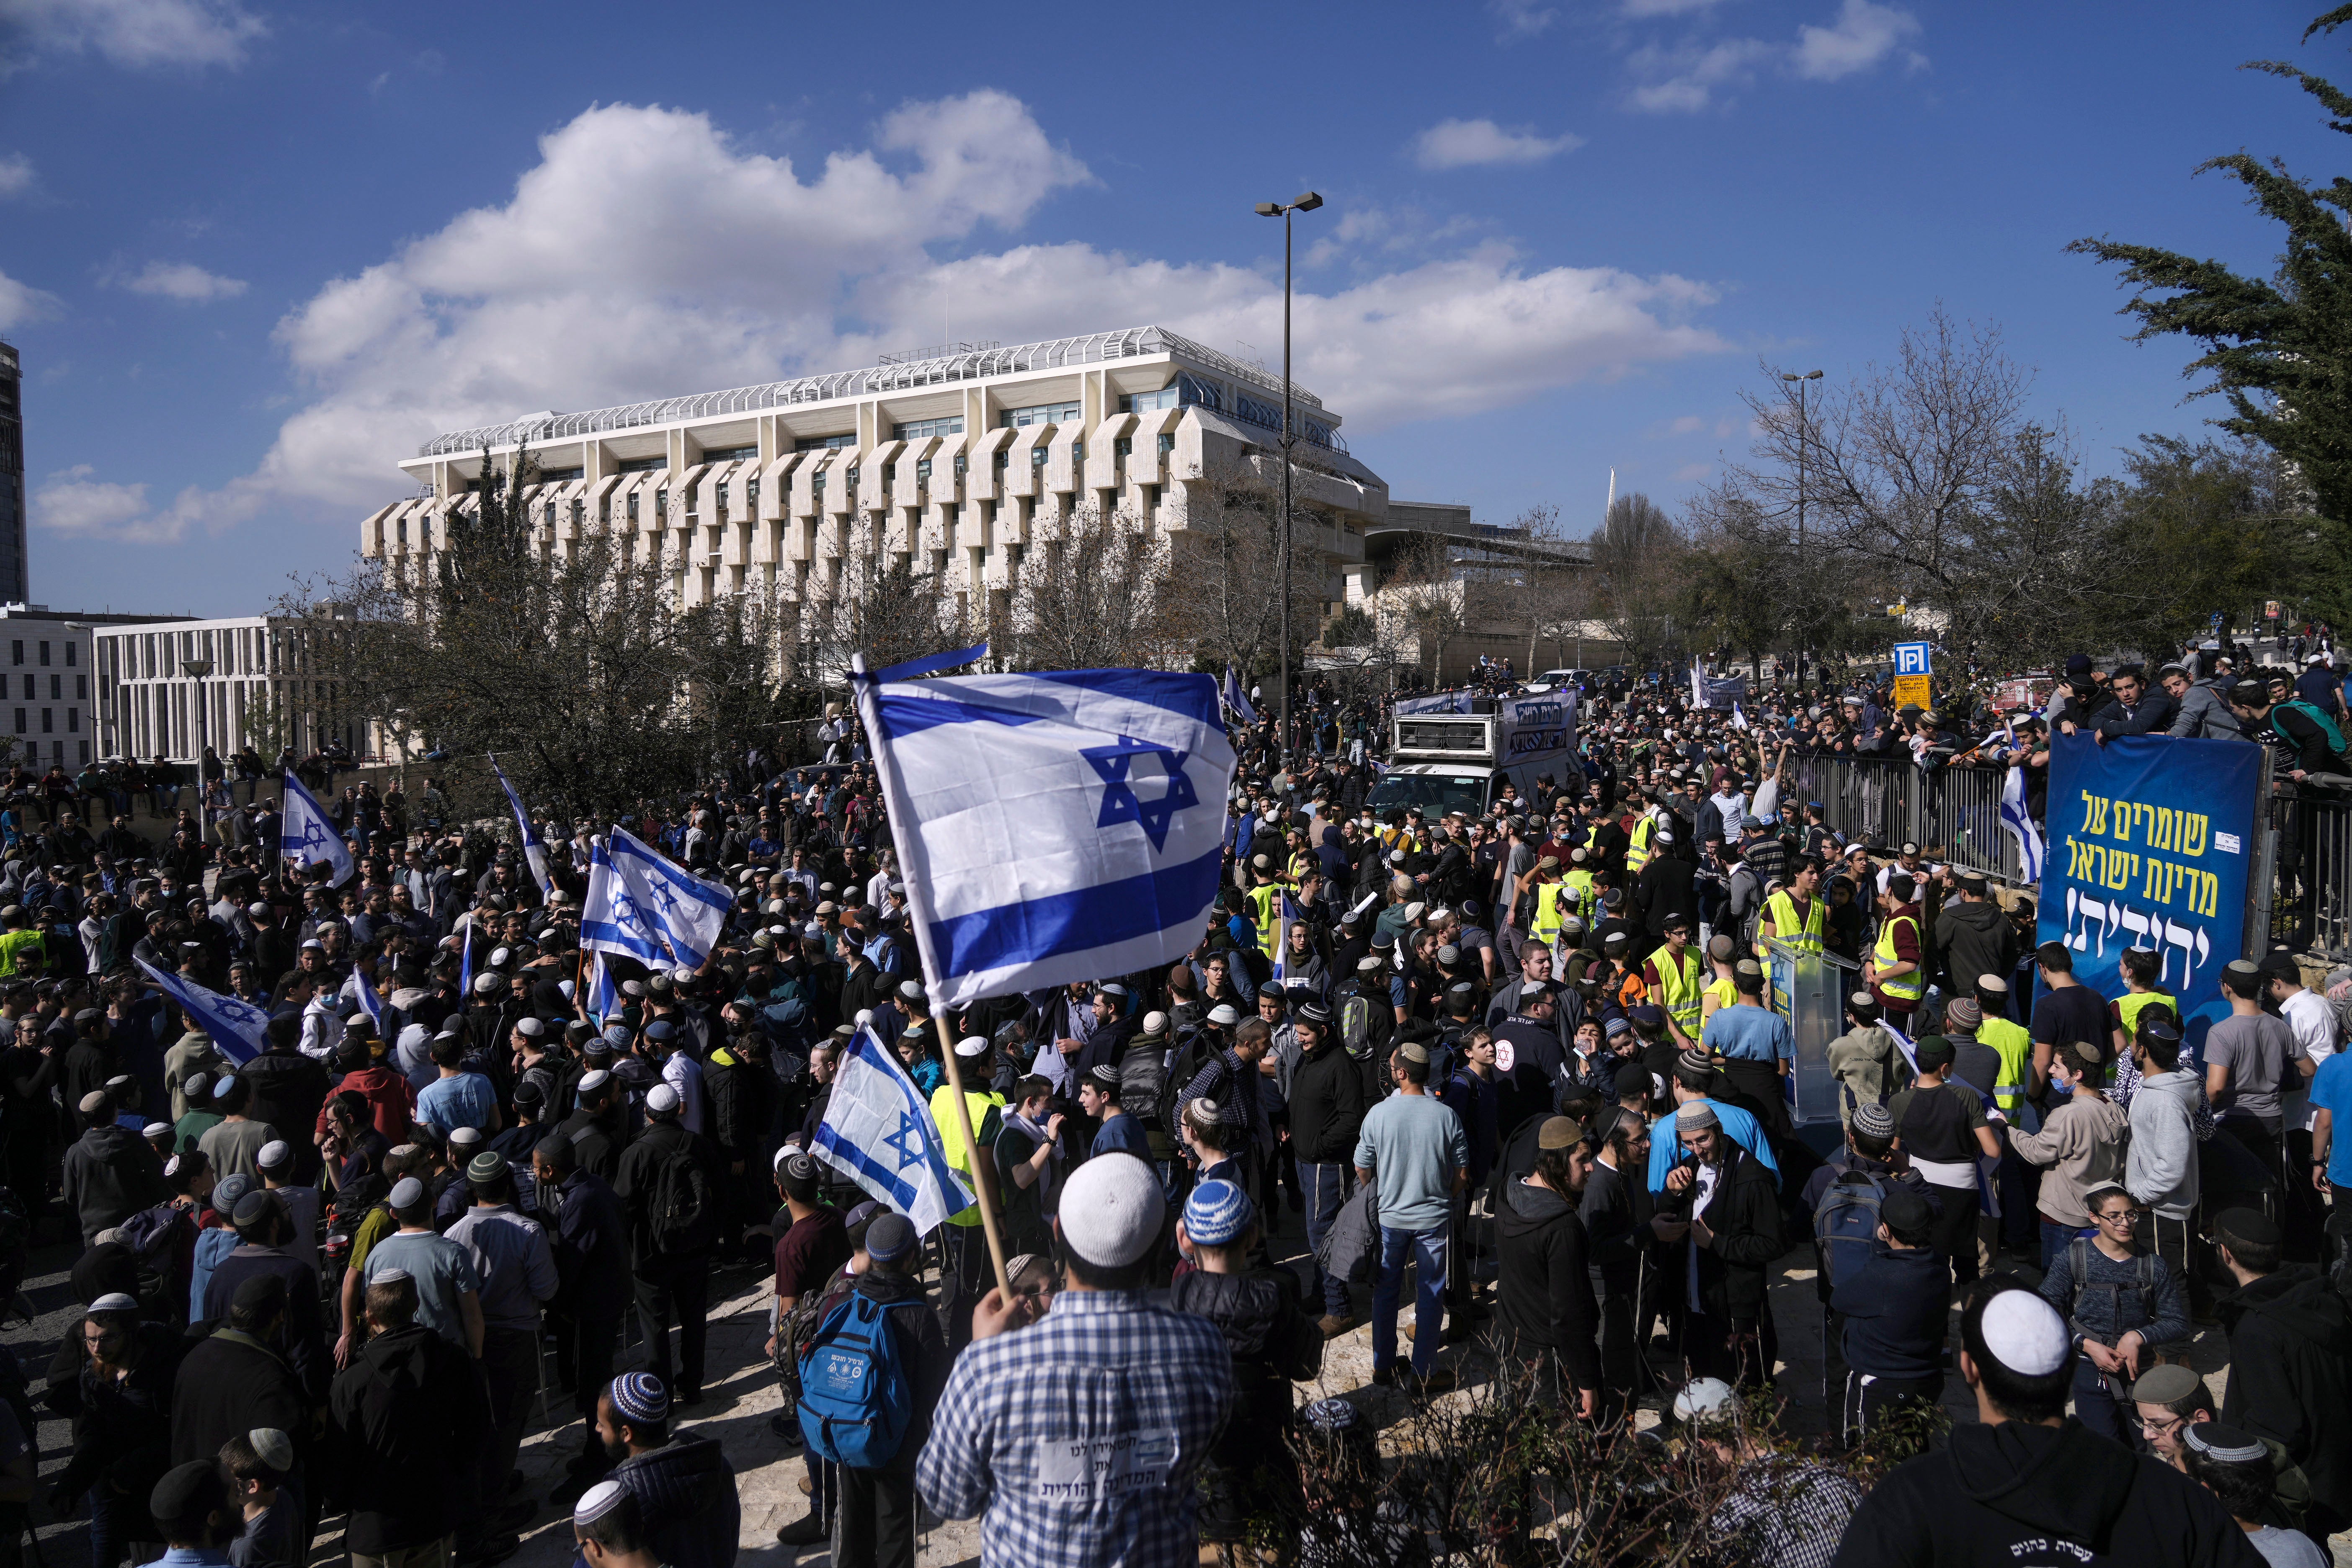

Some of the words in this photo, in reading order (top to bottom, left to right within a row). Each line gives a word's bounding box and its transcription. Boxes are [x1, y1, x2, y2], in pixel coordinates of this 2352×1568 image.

[1540, 705, 1560, 723] העם
[2081, 789, 2109, 835] על
[2113, 800, 2208, 857] שומרים
[2066, 835, 2139, 890] ישראל
[2143, 857, 2218, 918] מדינת
[2063, 887, 2210, 991] יהודית!
[831, 1354, 846, 1362] חובש
[848, 1357, 864, 1366] תרמיל
[1070, 1442, 1088, 1457] לנו
[1091, 1436, 1137, 1455] תשאירו
[1094, 1460, 1113, 1472] את
[1042, 1480, 1096, 1497] יהודית
[1104, 1470, 1156, 1494] המדינה
[2010, 1538, 2047, 1557] כהנים
[2055, 1539, 2094, 1562] עטרת
